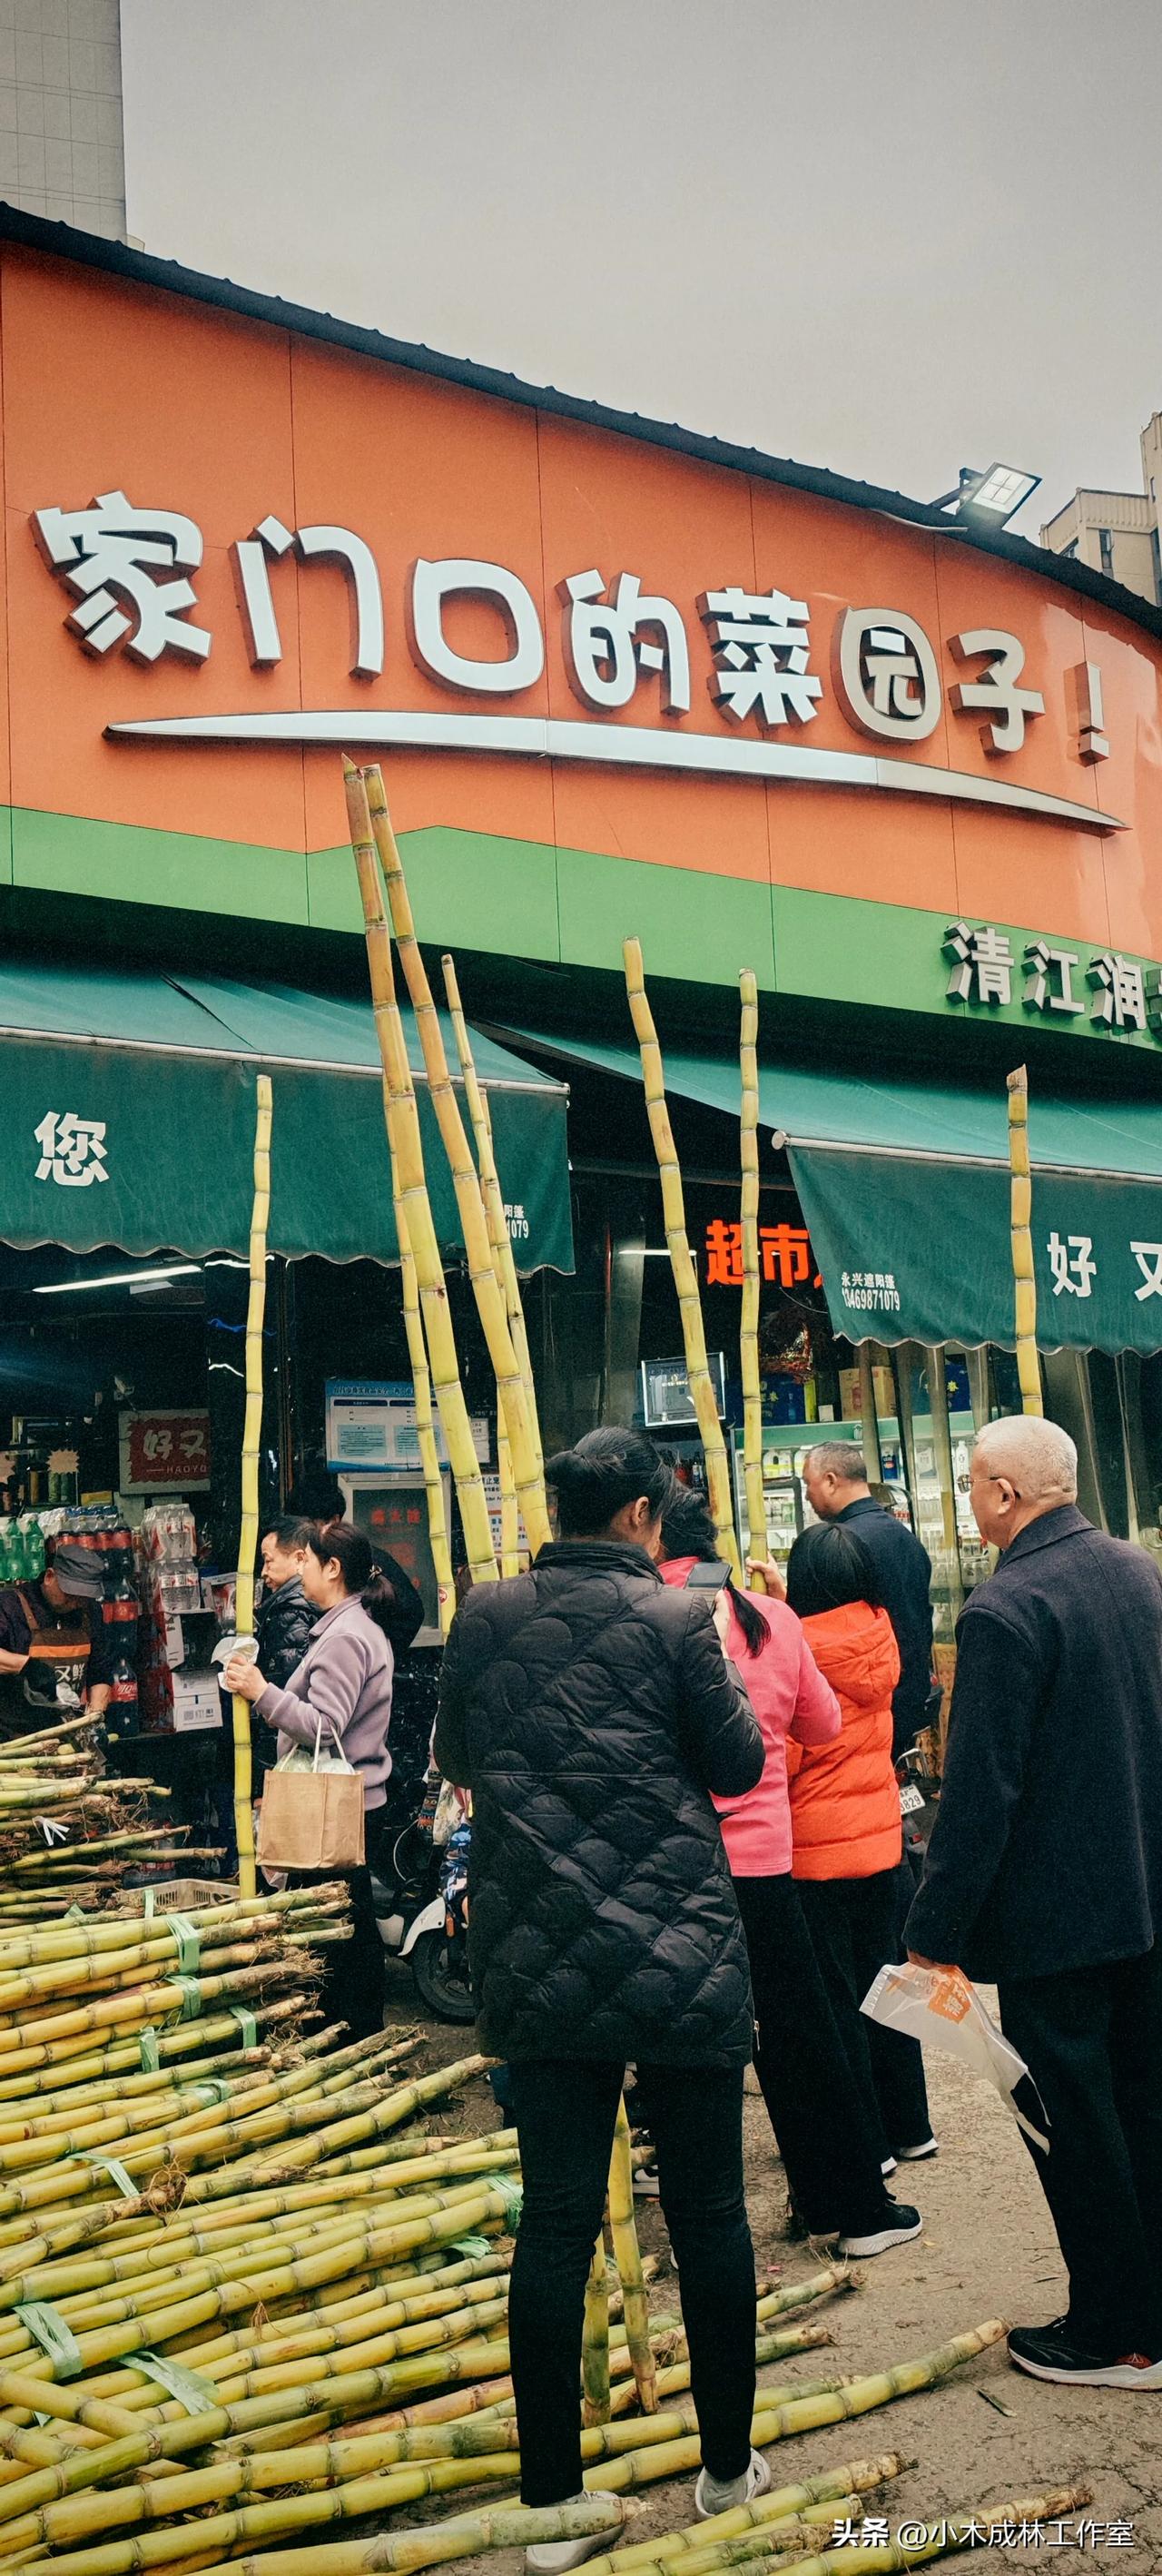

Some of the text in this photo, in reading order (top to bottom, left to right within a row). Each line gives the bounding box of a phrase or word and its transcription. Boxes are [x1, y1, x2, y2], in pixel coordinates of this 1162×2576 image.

[940, 921, 1162, 1031] 清江润
[34, 1110, 110, 1187] 您
[705, 1219, 823, 1288] 超市
[842, 1288, 901, 1311] 13469871079
[143, 1429, 207, 1461] 好又
[54, 1663, 85, 1682] 又鲜
